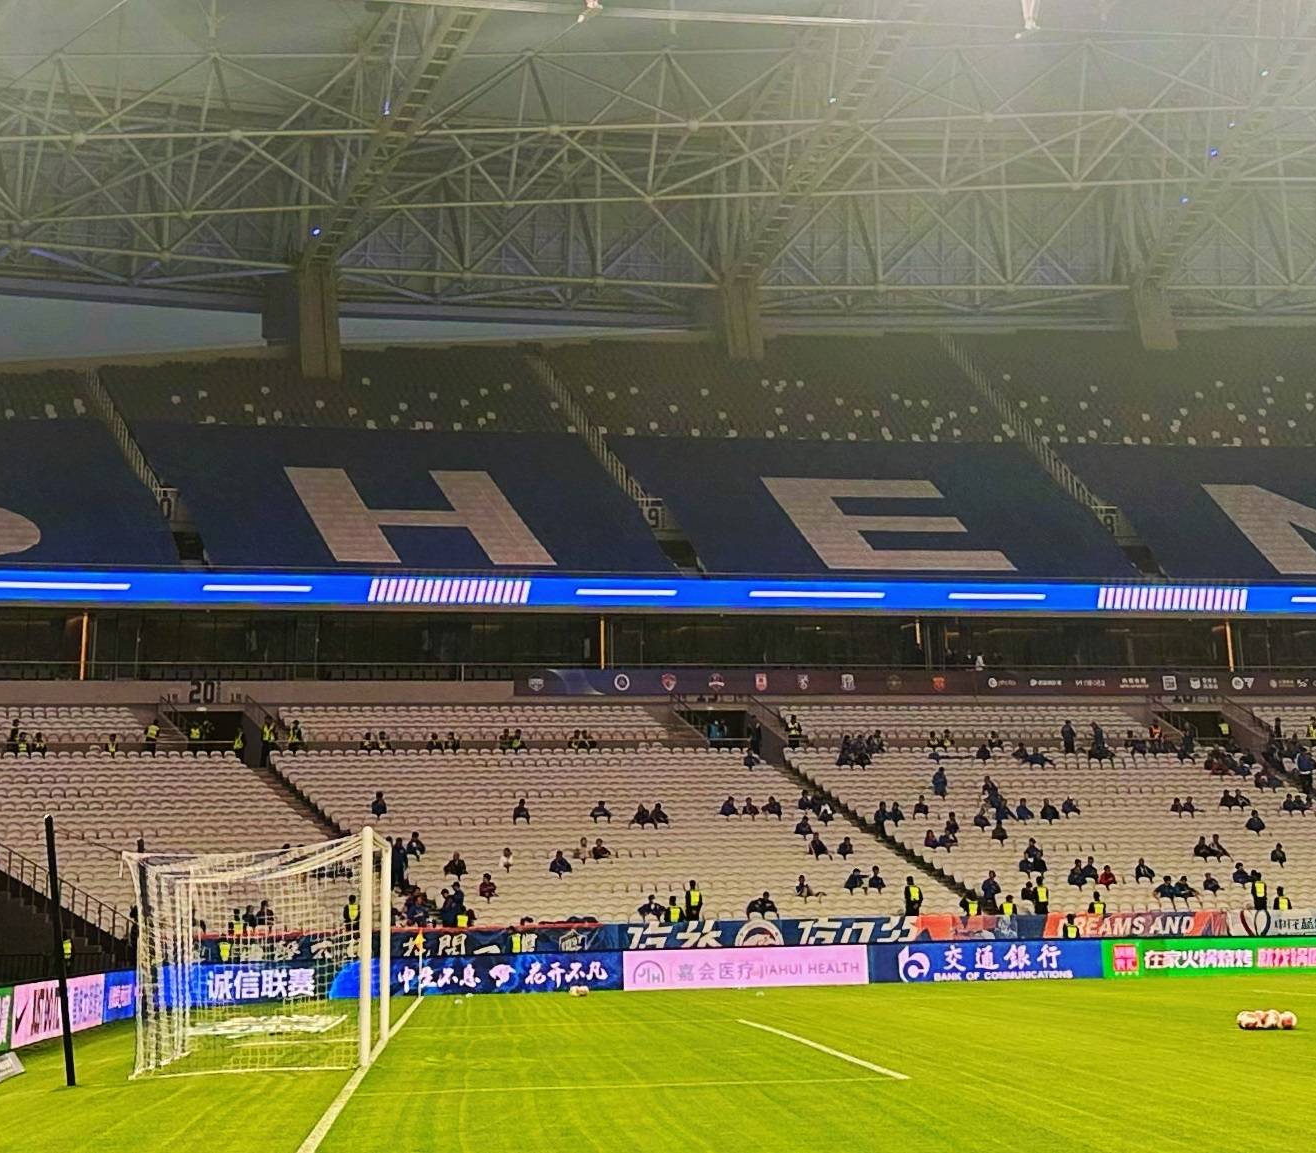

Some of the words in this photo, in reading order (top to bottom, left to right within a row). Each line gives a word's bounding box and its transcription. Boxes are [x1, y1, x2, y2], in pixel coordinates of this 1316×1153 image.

[189, 679, 215, 705] 20
[1150, 916, 1195, 937] AND
[807, 962, 860, 975] HEALTH
[943, 944, 1063, 971] 交通銀行
[207, 968, 316, 1001] 诚信联赛
[933, 972, 961, 982] BANK
[965, 972, 981, 982] OF
[983, 969, 1074, 982] COMMUNICATIONS
